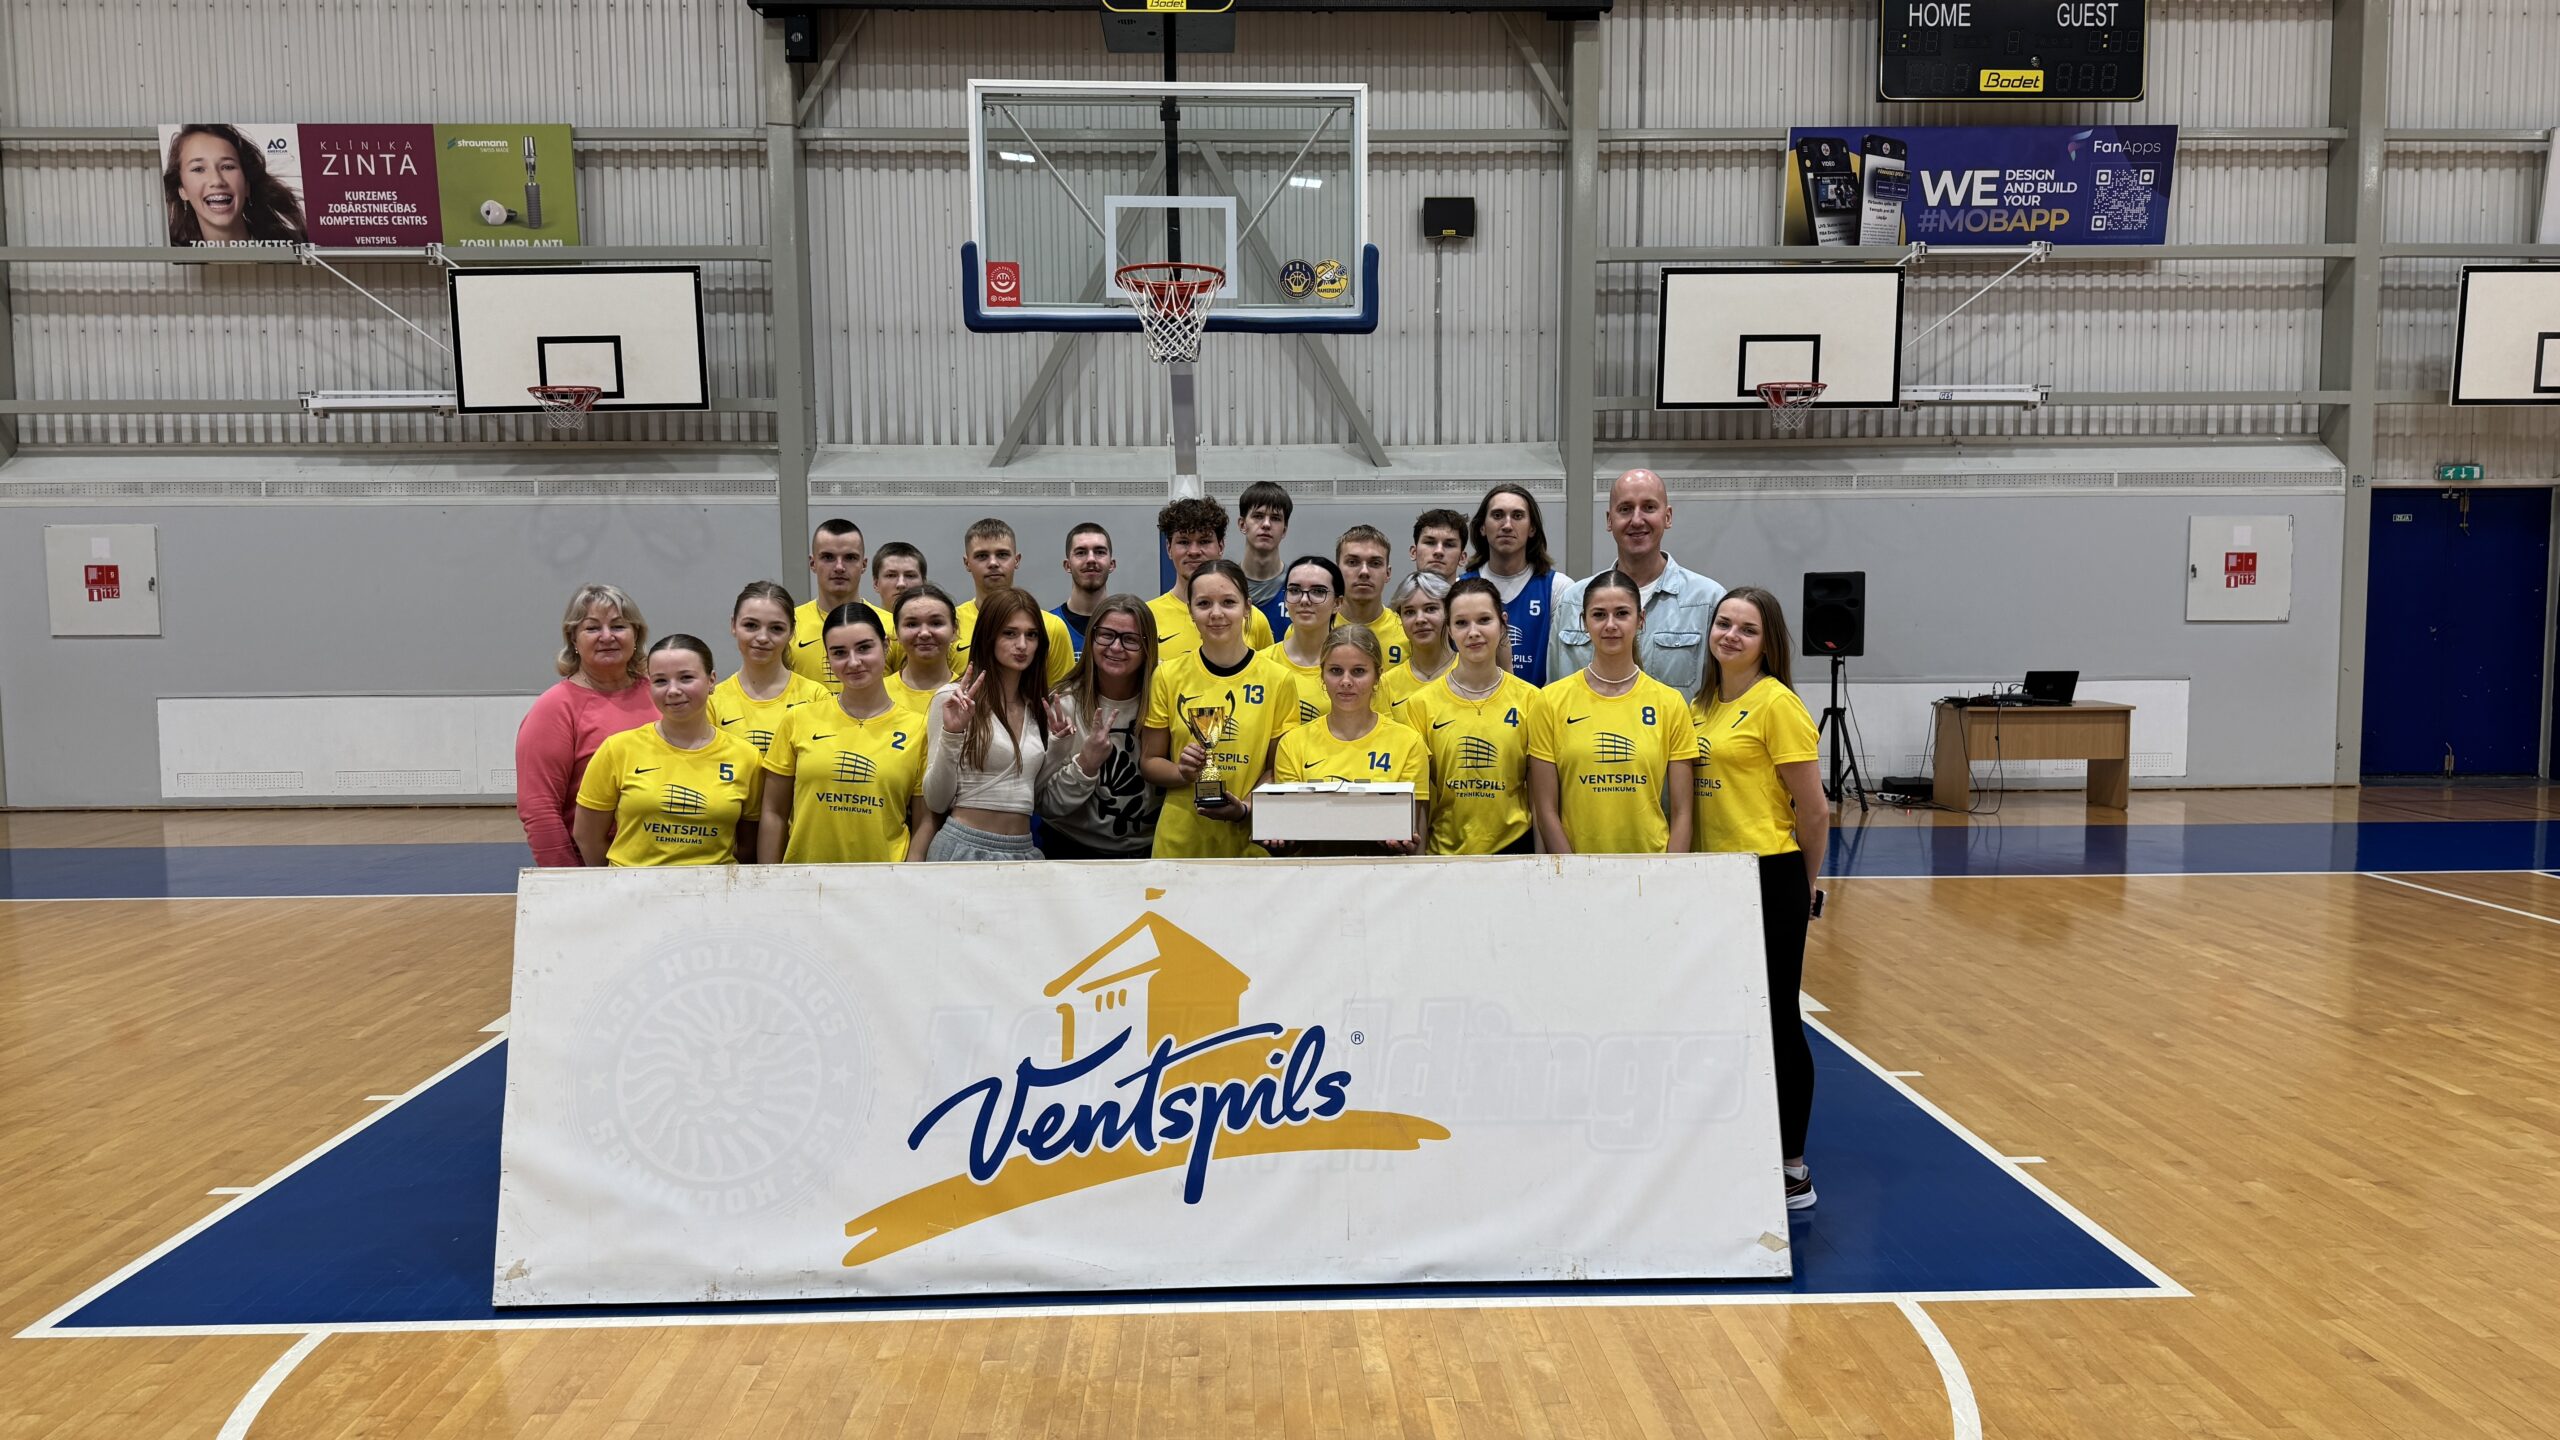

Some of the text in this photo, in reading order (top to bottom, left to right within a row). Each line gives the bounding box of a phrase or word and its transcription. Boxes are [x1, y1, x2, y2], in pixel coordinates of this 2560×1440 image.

[1909, 3, 1971, 27] HOME
[2057, 3, 2119, 27] GUEST
[1984, 72, 2040, 88] Bodet
[267, 138, 287, 149] AO
[457, 139, 508, 147] straumann
[2094, 140, 2161, 156] FanApps
[322, 154, 418, 175] ZINTA
[2005, 169, 2055, 181] DESIGN
[1920, 170, 2000, 206] WE
[2003, 182, 2077, 194] AND BUILD
[345, 191, 398, 201] KURZEMES
[2004, 195, 2040, 206] YOUR
[328, 202, 417, 213] ZOBĀRSTNIECĪBAS
[319, 216, 428, 226] KOMPETENCES CENTRS
[1918, 208, 2070, 232] #MOBAPP
[355, 236, 397, 245] VENTSPILS
[2240, 574, 2256, 584] 112
[102, 588, 119, 598] 112
[1529, 600, 1541, 616] 5
[1388, 646, 1401, 663] 9
[1243, 684, 1264, 704] 13
[1504, 708, 1519, 727] 4
[1641, 706, 1656, 726] 8
[1731, 711, 1748, 728] 7
[891, 732, 906, 750] 2
[1368, 751, 1391, 772] 14
[719, 763, 733, 781] 5
[1579, 774, 1647, 785] VENTSPILS
[1446, 780, 1506, 791] VENTSPILS
[816, 793, 884, 807] VENTSPILS
[829, 805, 872, 814] TEHNIKUMS
[643, 822, 718, 837] VENTSPILS
[655, 836, 703, 845] TEHNIKUMS
[908, 1024, 1351, 1204] Ventspils
